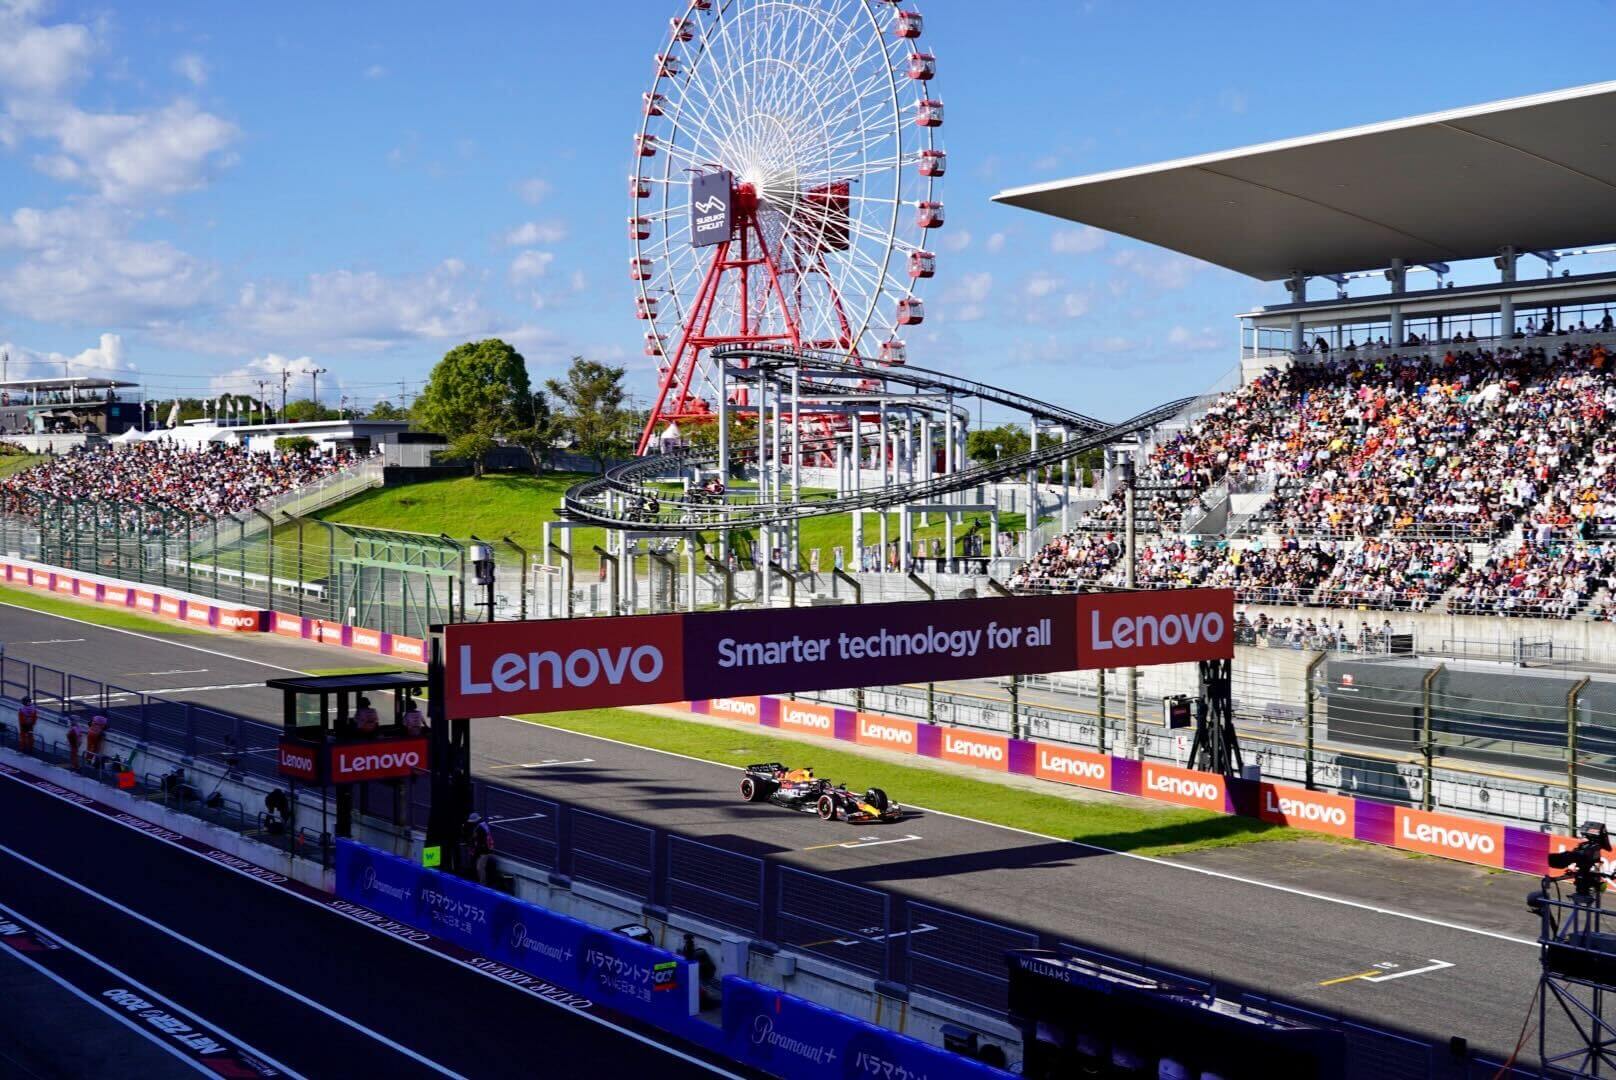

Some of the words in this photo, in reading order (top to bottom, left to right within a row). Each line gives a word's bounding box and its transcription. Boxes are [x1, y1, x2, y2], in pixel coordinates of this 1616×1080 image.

[697, 220, 725, 232] CIRCUIT
[718, 634, 831, 669] Smarter
[838, 625, 982, 660] technology
[986, 621, 1021, 649] for
[1025, 618, 1052, 647] all
[1091, 609, 1224, 651] Lenovo
[460, 644, 664, 696] Lenovo
[783, 706, 830, 729] Lenovo
[861, 719, 913, 746] Lenovo
[281, 748, 313, 773] Lenovo
[339, 751, 420, 773] Lenovo
[945, 733, 1003, 762] Lenovo
[1041, 750, 1106, 780] Lenovo
[1147, 769, 1218, 801] Lenovo
[1266, 790, 1347, 826] Lenovo
[1403, 815, 1495, 855] Lenovo
[1020, 958, 1071, 983] WILLIAMS
